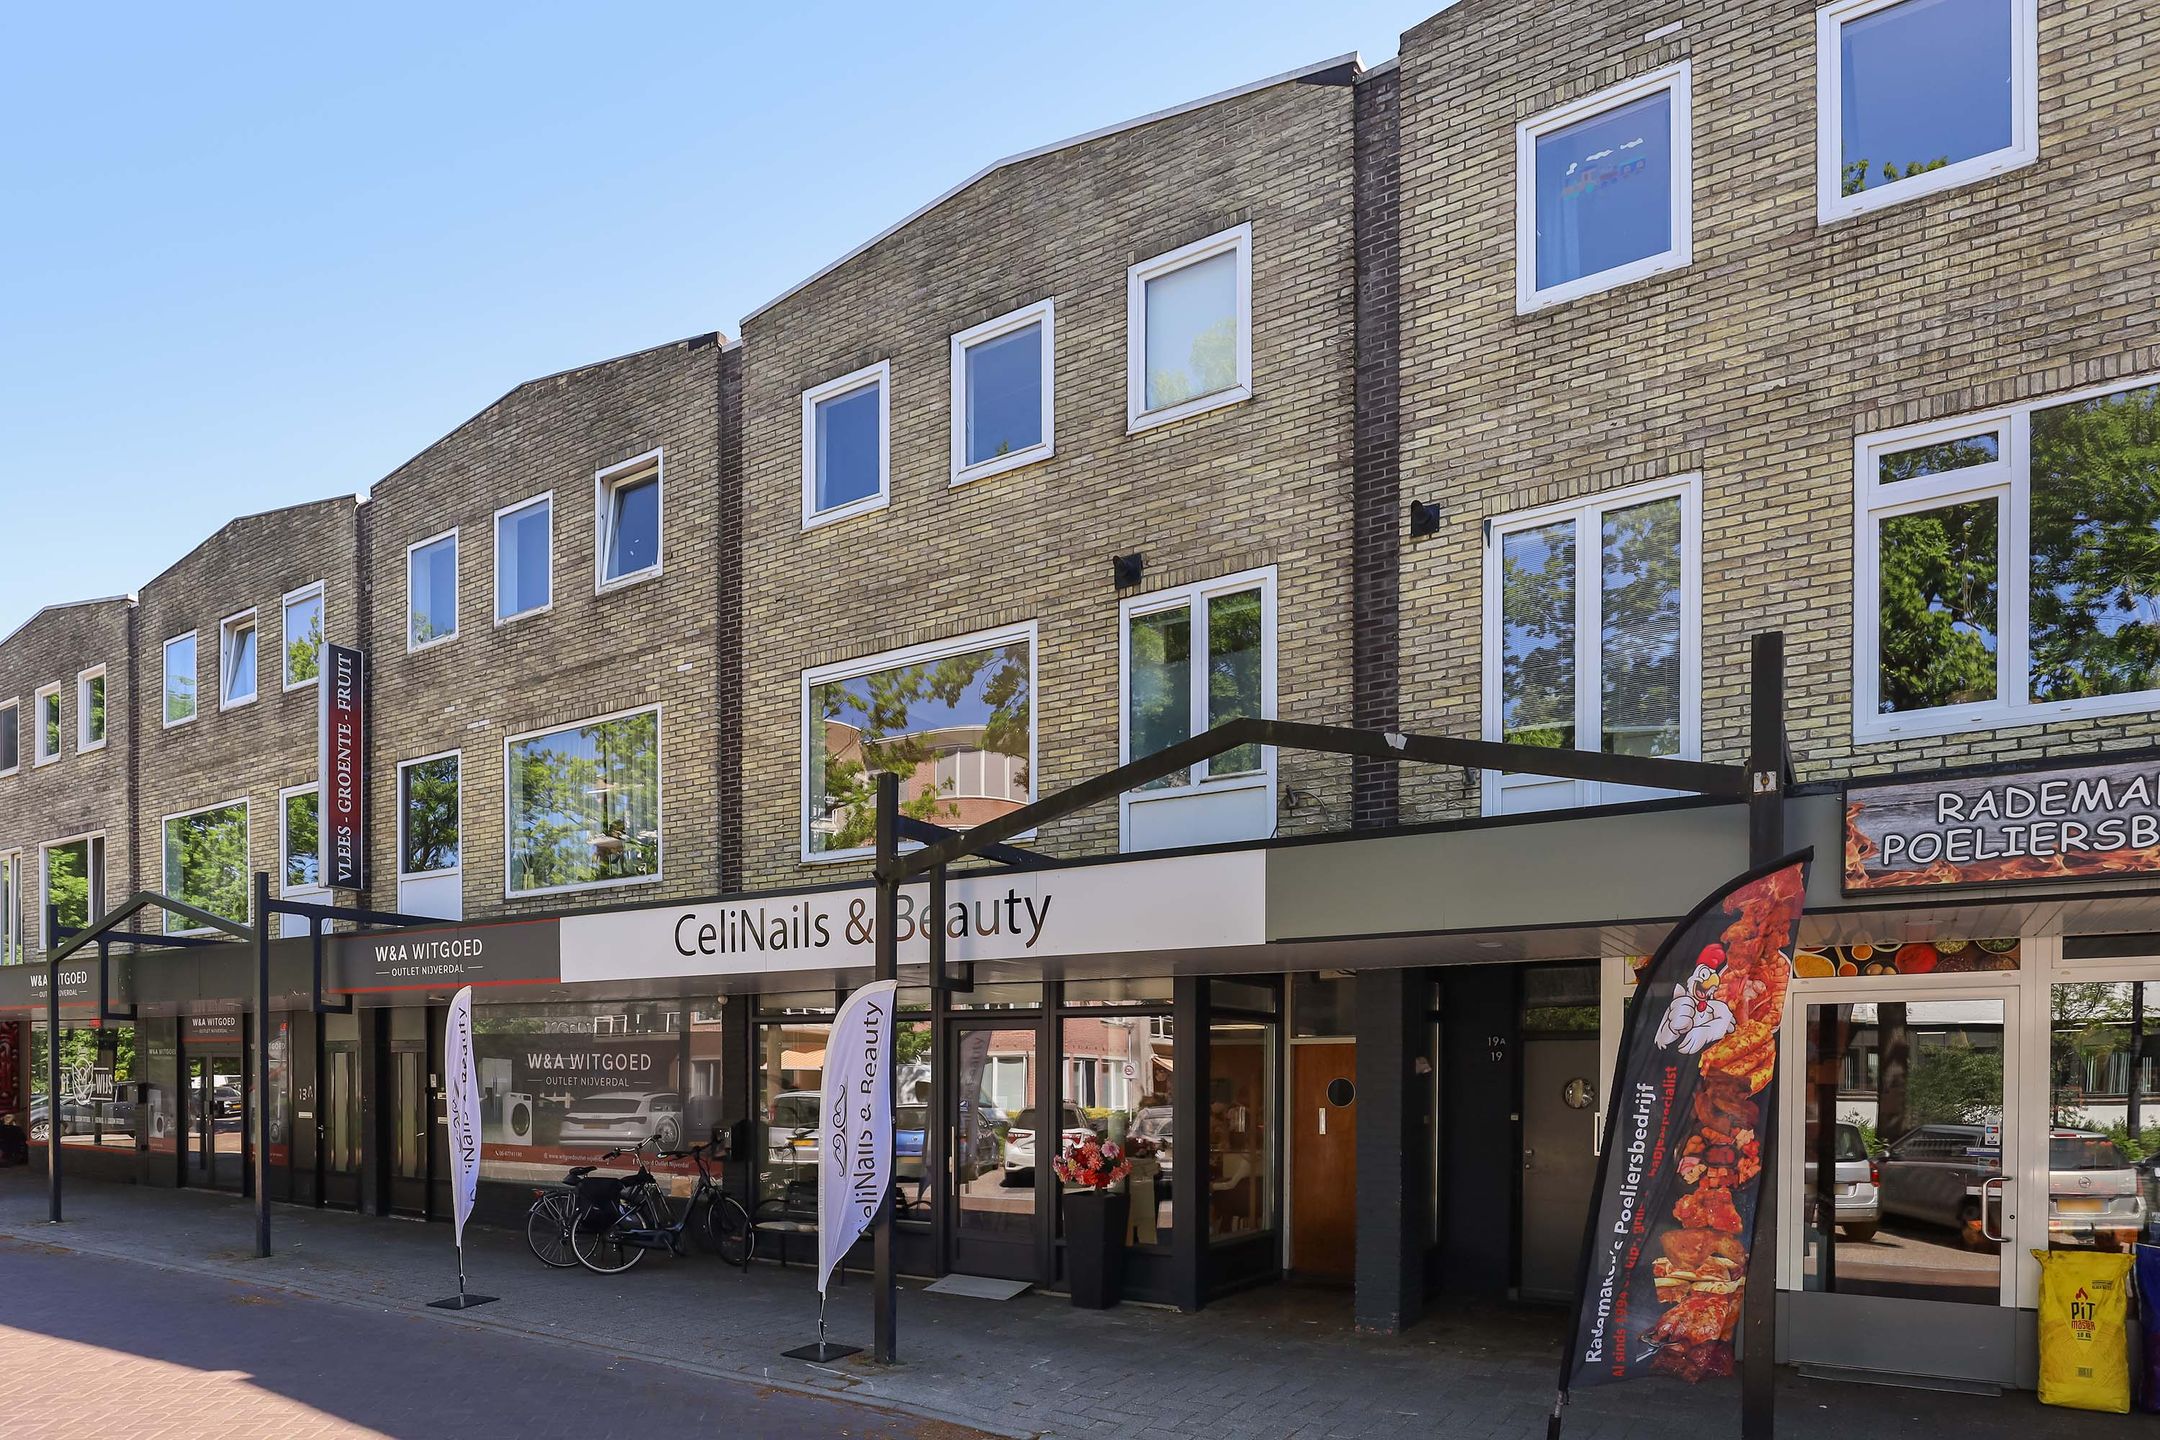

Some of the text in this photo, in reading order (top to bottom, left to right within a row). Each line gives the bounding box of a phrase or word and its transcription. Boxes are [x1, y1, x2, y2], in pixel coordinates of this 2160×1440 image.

[337, 653, 352, 712] FRUIT
[337, 722, 352, 813] GROENTE
[1938, 773, 2160, 823] RADEMA
[337, 824, 352, 882] VLEES
[1883, 815, 2160, 865] POELIERSB
[674, 888, 1052, 956] CeliNails & Beauty
[375, 938, 483, 962] W&A WITGOED
[30, 970, 88, 987] W&A ITGOED
[391, 963, 465, 977] OUTLET NIJVERDAL
[191, 1017, 236, 1027] W&A WITGOED
[1488, 1036, 1506, 1046] 19A
[527, 1053, 652, 1071] W&A WITGOED
[1491, 1051, 1503, 1061] 19
[545, 1076, 630, 1087] OUTLET NIJVERDAL
[1614, 1083, 1657, 1234] Poeliersbedrijf
[1613, 1328, 1627, 1362] sinds
